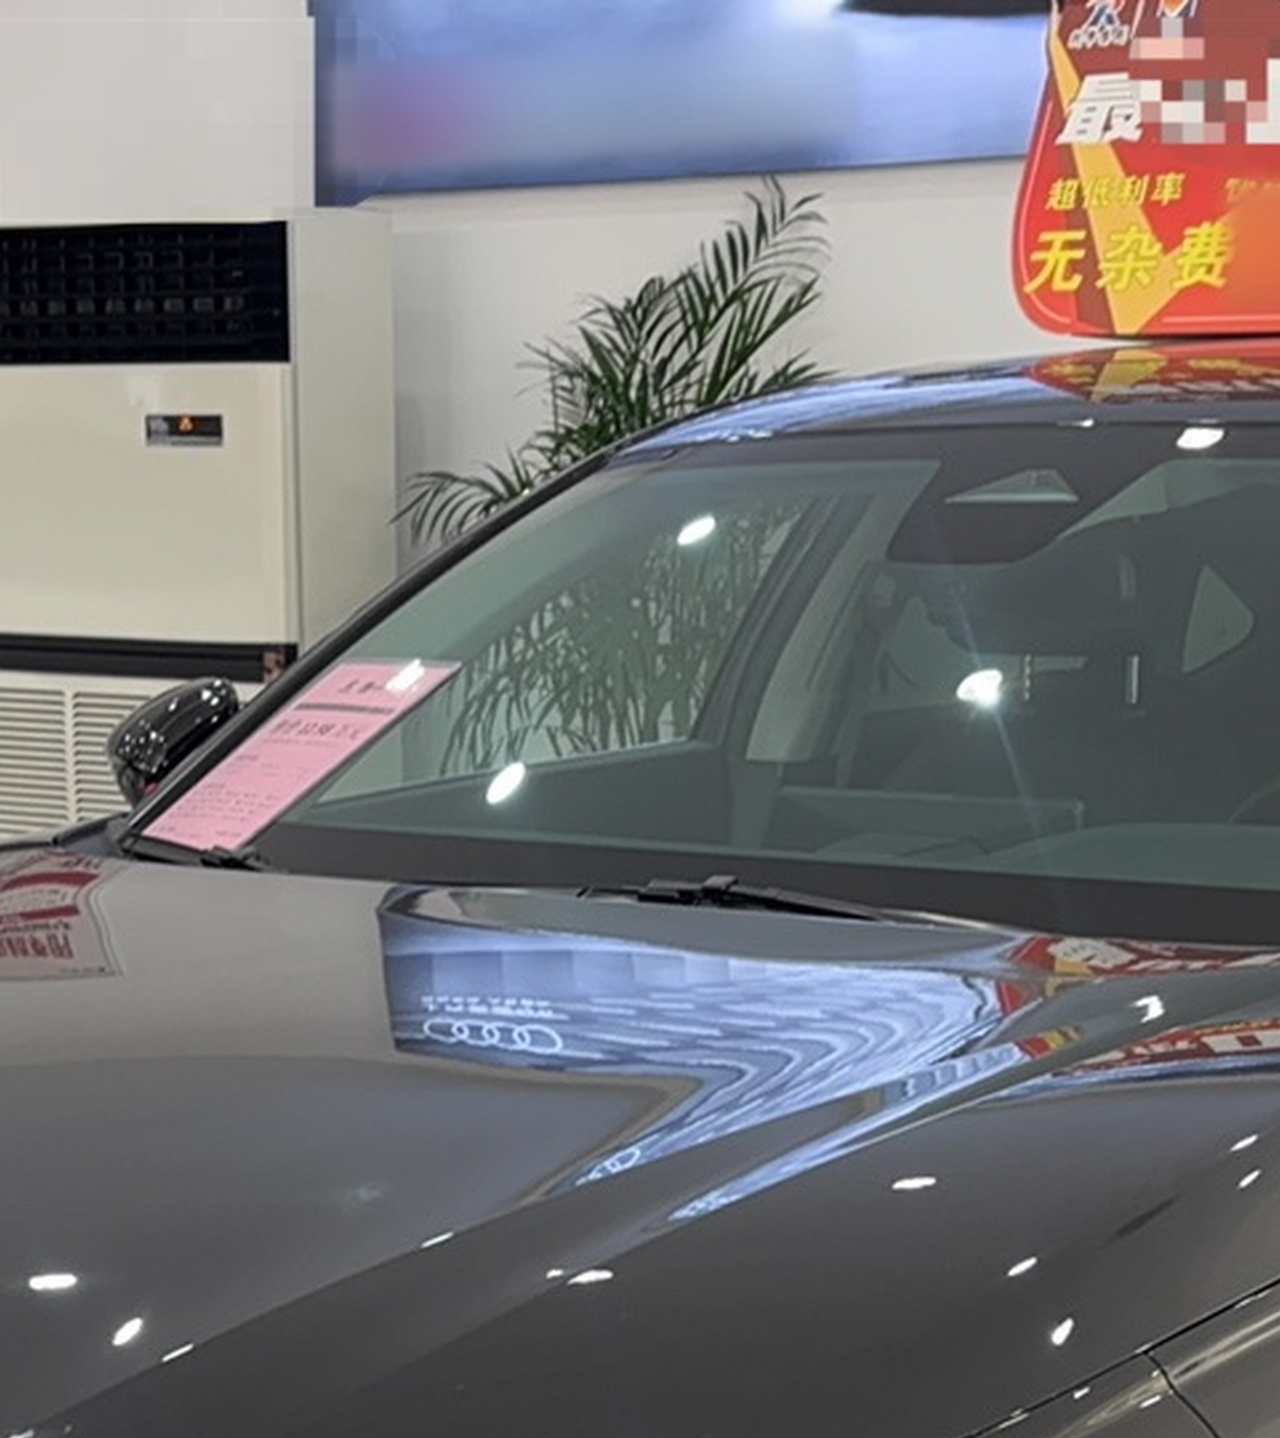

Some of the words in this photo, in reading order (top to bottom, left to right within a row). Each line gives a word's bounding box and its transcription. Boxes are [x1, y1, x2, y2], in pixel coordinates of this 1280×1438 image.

[1045, 172, 1185, 210] 超低利率
[1023, 221, 1233, 294] 无杂费
